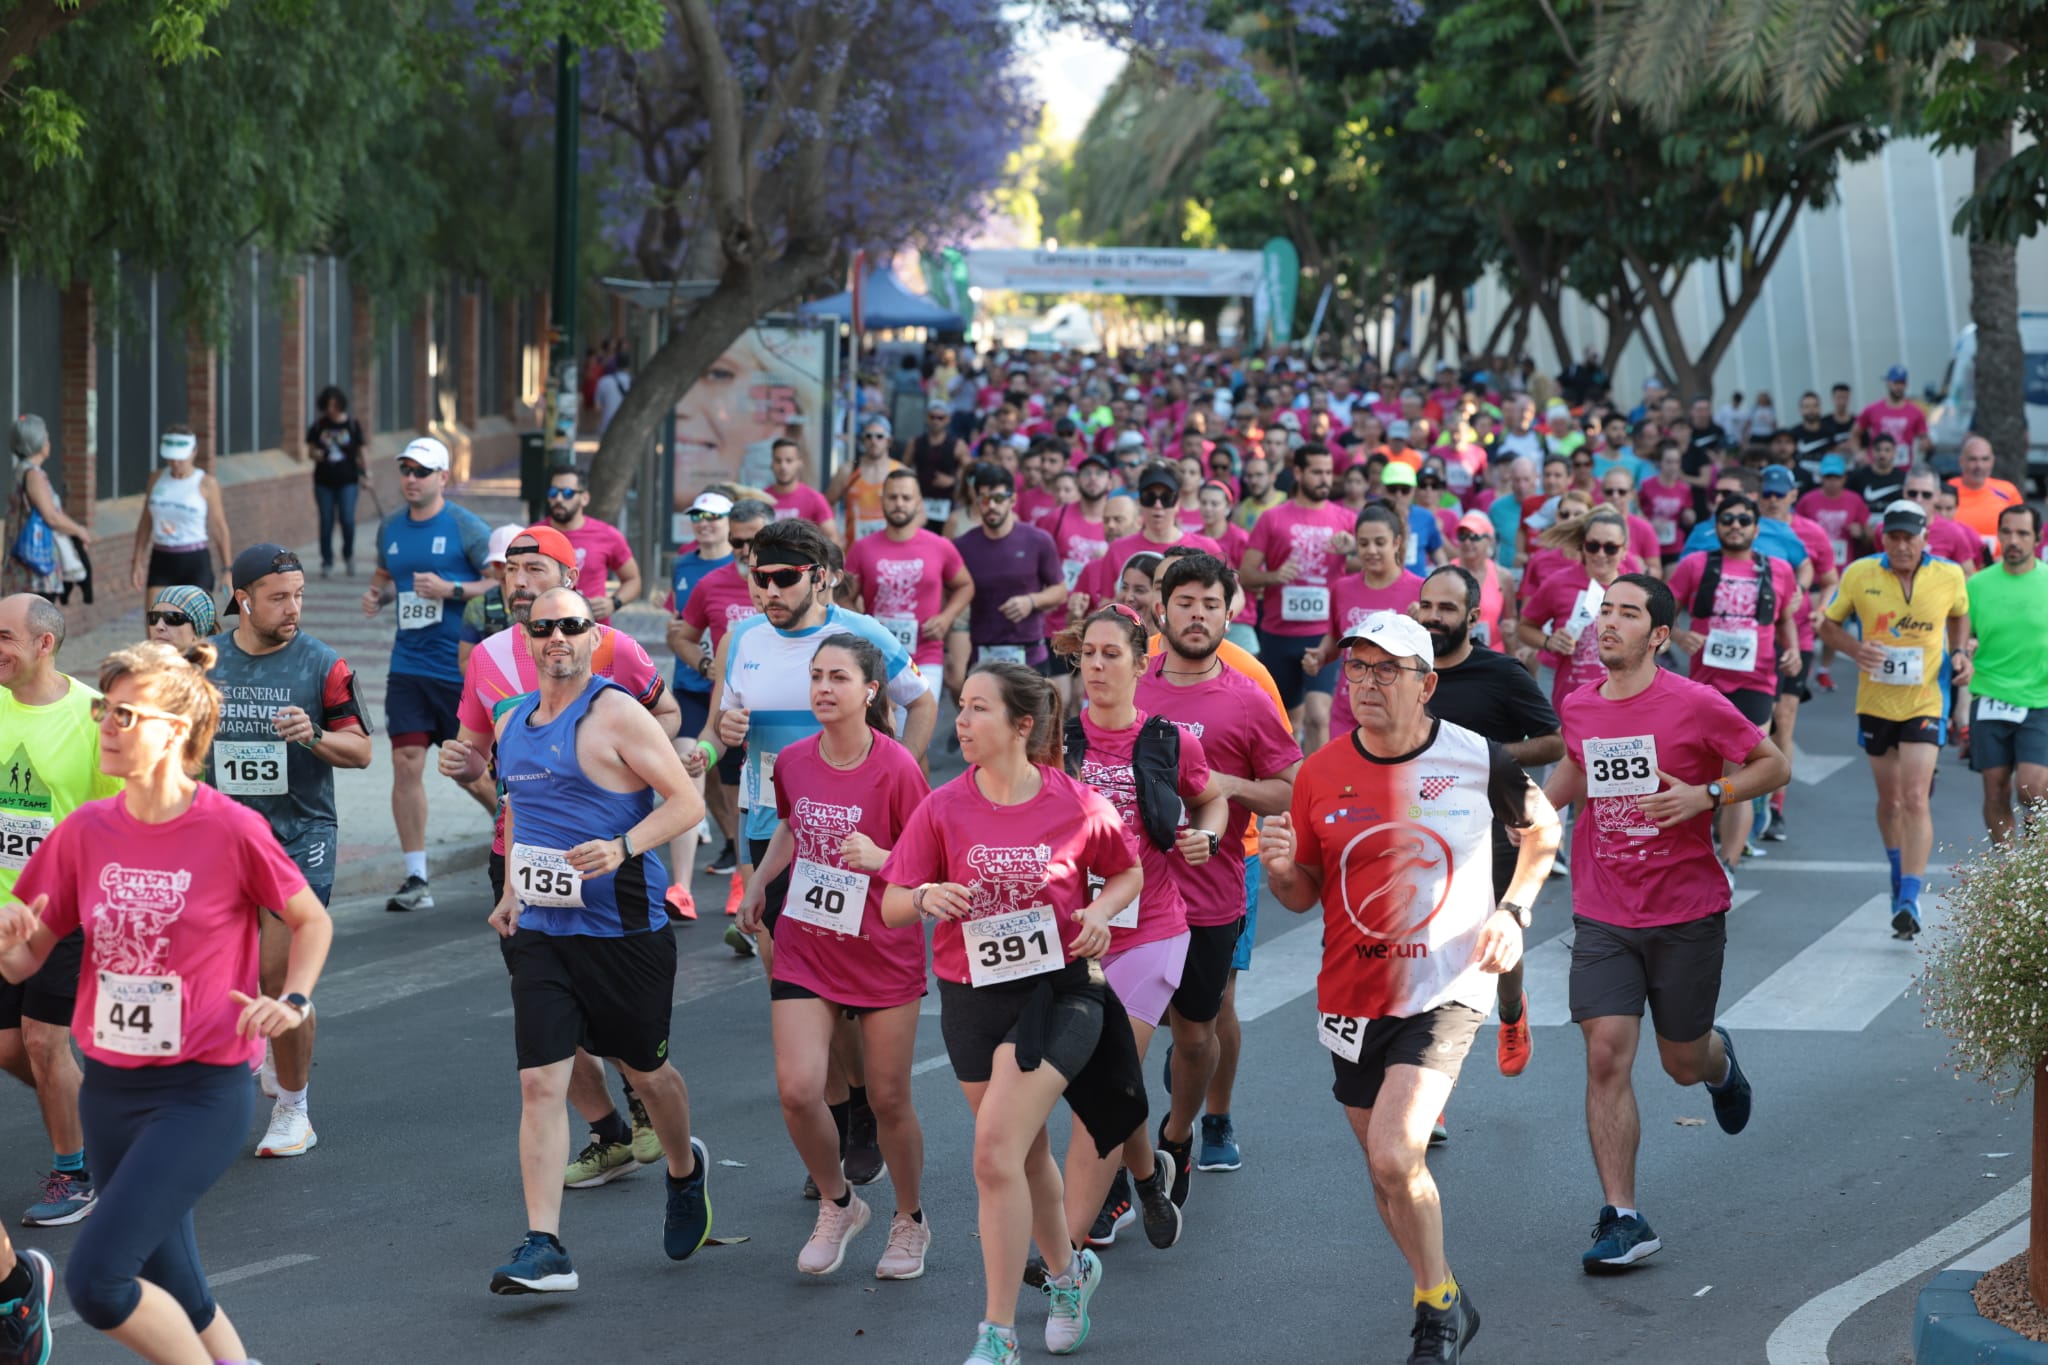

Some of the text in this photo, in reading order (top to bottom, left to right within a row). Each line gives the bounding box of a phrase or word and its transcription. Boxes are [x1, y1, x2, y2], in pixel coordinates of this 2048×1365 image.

[402, 604, 437, 619] 288
[1288, 598, 1324, 612] 500
[1711, 643, 1750, 660] 637
[1883, 660, 1908, 675] 91
[232, 686, 292, 702] GENERALI
[215, 720, 281, 735] MARATHO
[223, 760, 280, 781] 163
[1593, 756, 1651, 782] 383
[798, 800, 848, 819] Carrera
[802, 812, 850, 831] Prensa
[972, 847, 1037, 861] Carrera
[981, 859, 1045, 875] Prensa
[518, 866, 574, 897] 135
[804, 885, 846, 914] 40
[978, 930, 1049, 967] 391
[109, 1002, 154, 1034] 44
[1321, 1011, 1359, 1045] 22
